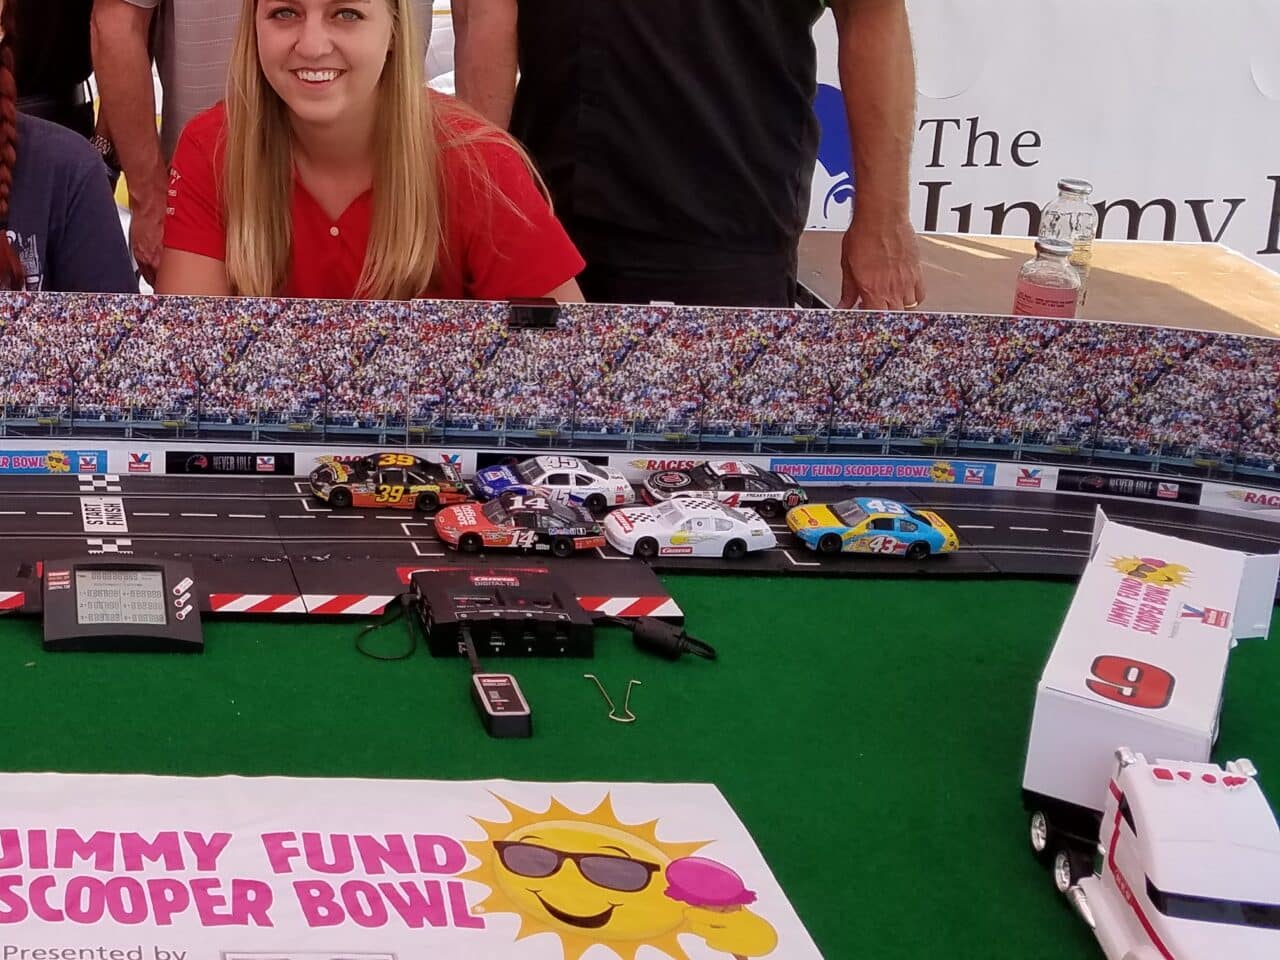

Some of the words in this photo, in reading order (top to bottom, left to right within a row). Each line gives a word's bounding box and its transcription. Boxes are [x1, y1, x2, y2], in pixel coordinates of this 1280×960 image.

[918, 115, 1042, 168] The
[13, 454, 46, 469] BOWL
[376, 454, 415, 467] 39
[774, 463, 809, 477] JIMMY
[812, 463, 842, 477] FUND
[845, 463, 895, 477] SCOOPER
[898, 464, 930, 478] BOWL
[375, 484, 405, 503] 39
[509, 495, 549, 510] 14
[721, 493, 741, 508] 4
[84, 503, 104, 526] START
[104, 502, 124, 527] FINISH
[867, 498, 906, 514] 43
[508, 530, 535, 548] 14
[869, 535, 897, 553] 43
[1116, 577, 1143, 601] FUND
[1106, 598, 1136, 628] JIMMY
[261, 832, 467, 875] FUND
[293, 879, 486, 929] BOWL
[2, 944, 143, 960] Presented
[154, 944, 187, 960] by
